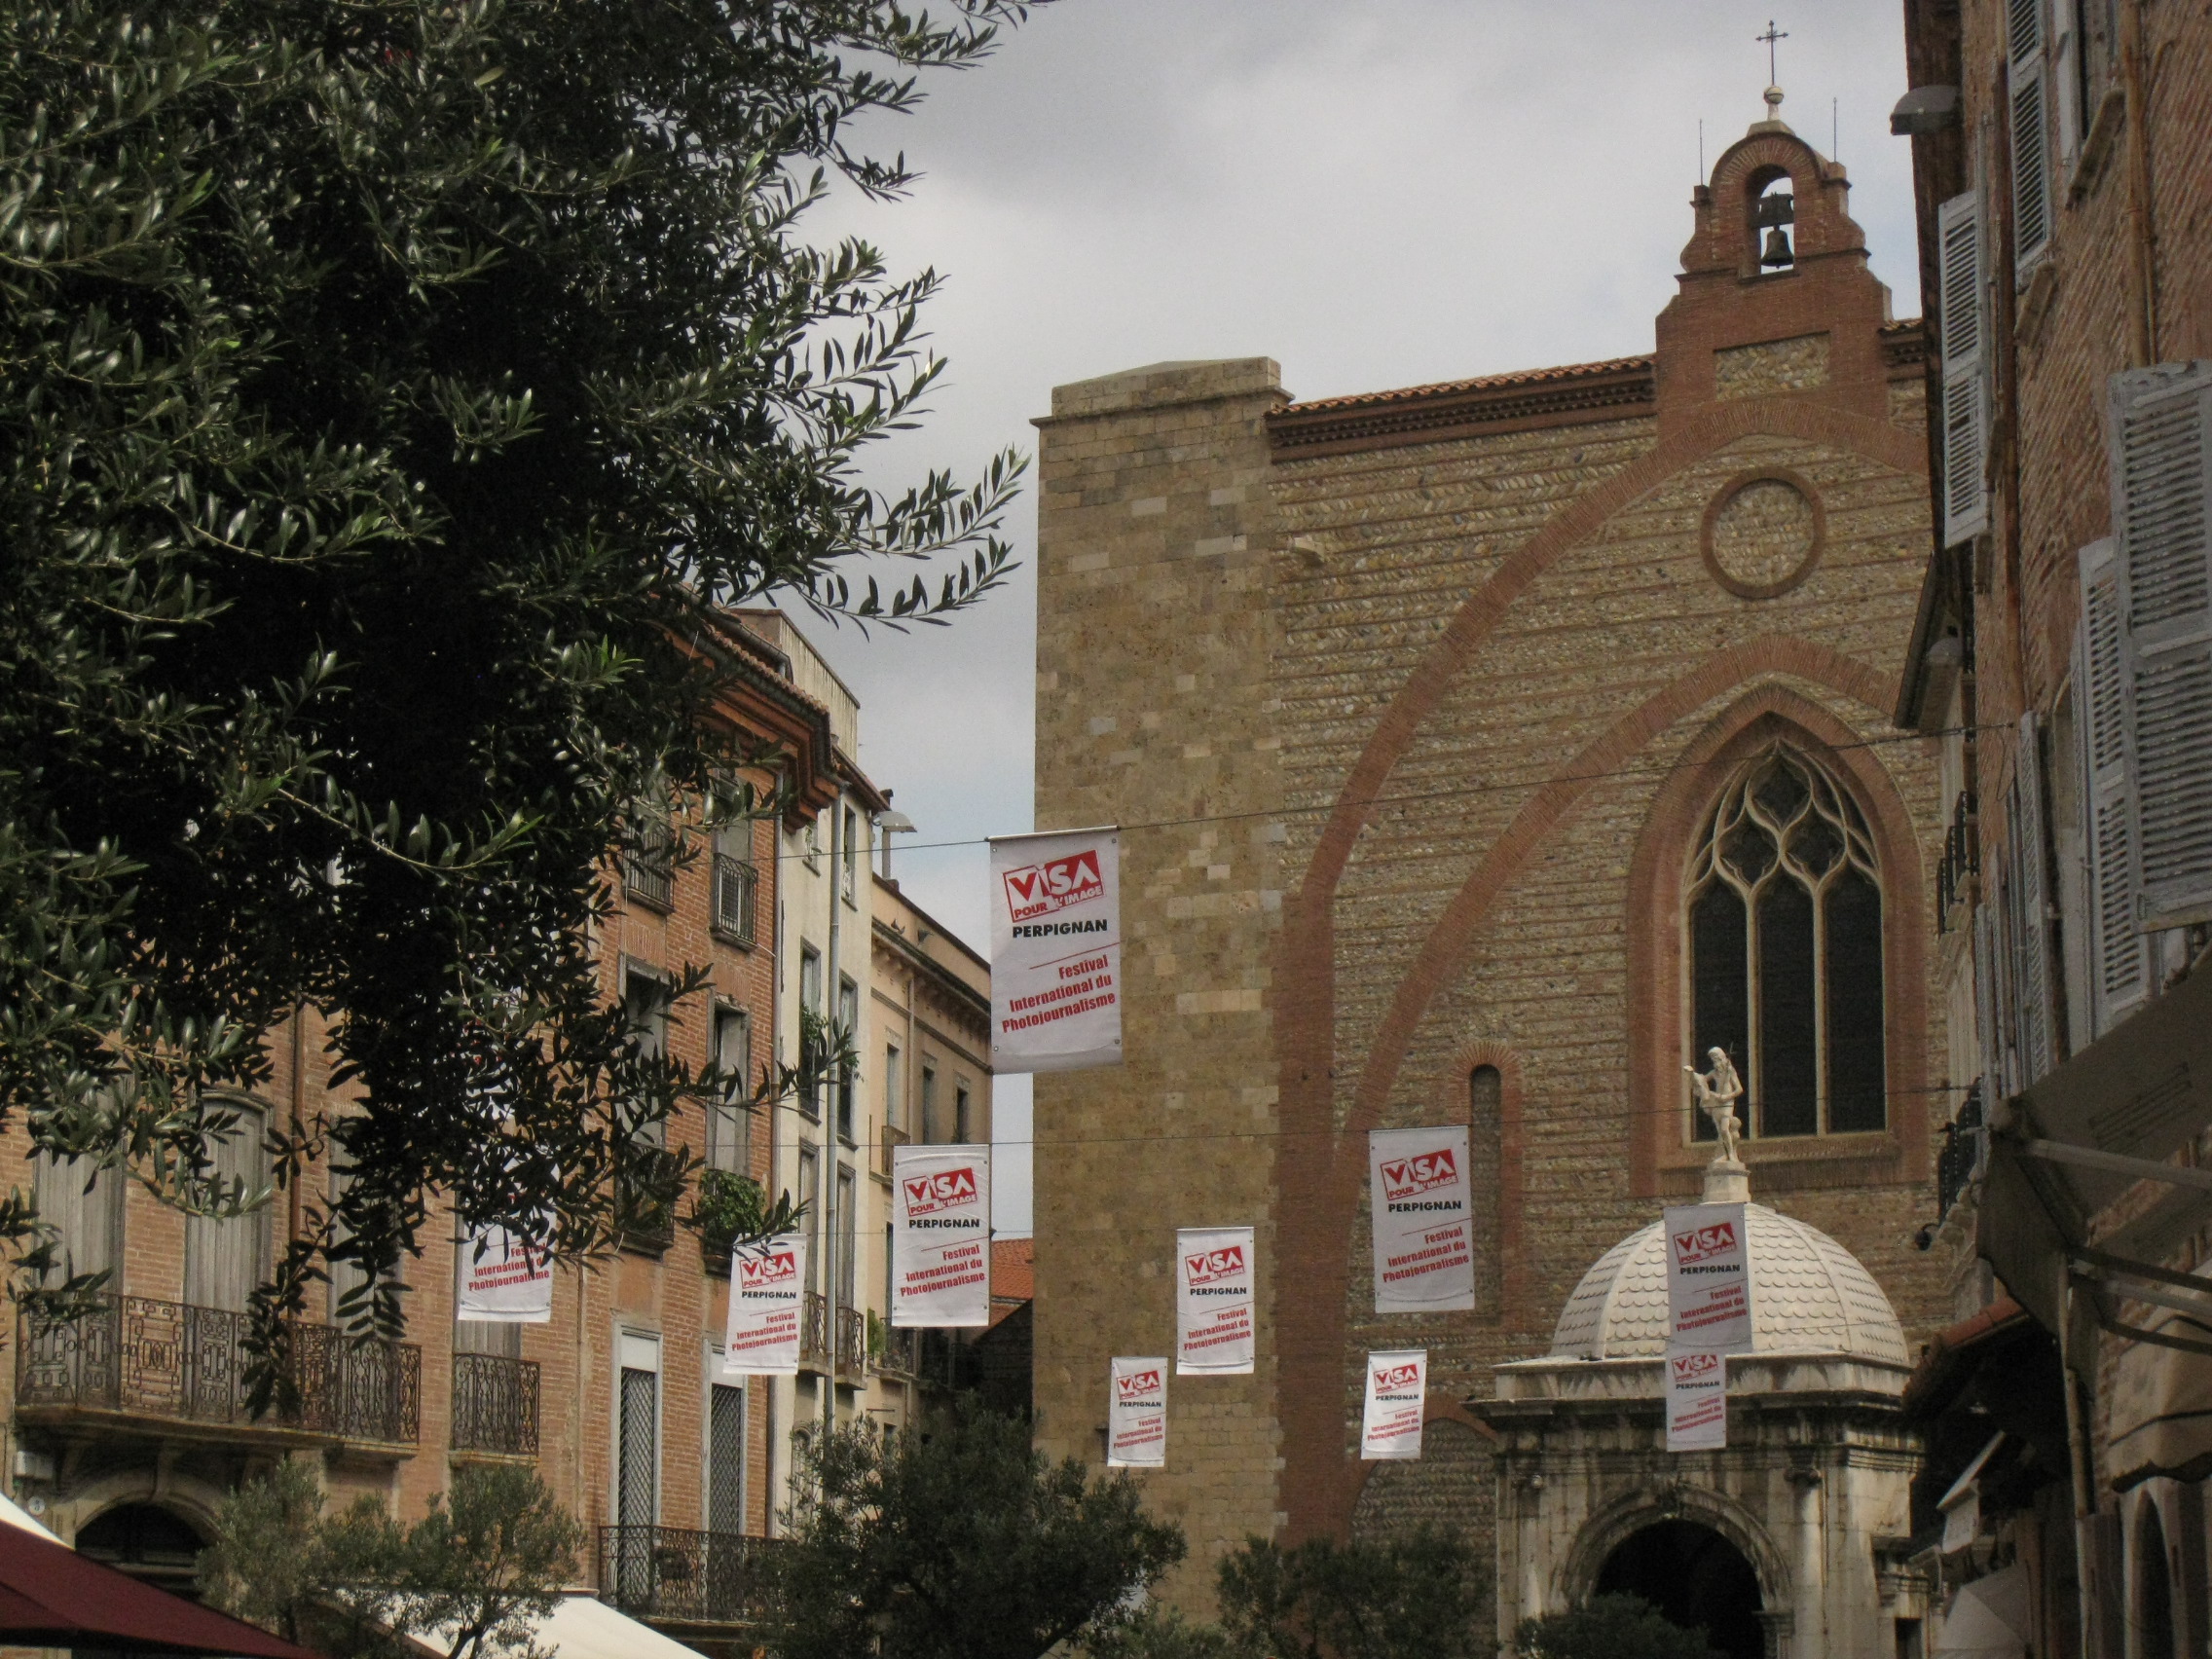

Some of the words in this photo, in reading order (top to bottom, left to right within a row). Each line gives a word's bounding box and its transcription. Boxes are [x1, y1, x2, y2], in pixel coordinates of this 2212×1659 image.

[1009, 859, 1100, 903] VISA
[1014, 901, 1048, 919] POUR
[1053, 884, 1103, 907] L'IMAGE
[1013, 919, 1108, 939] PERPIGNAN
[1058, 954, 1109, 979] Festival
[1010, 977, 1093, 1013] International
[1095, 974, 1112, 989] du
[1002, 992, 1116, 1033] Photojournalisme
[1384, 1156, 1456, 1185] VISA
[906, 1173, 975, 1201] VISA
[1389, 1186, 1414, 1198] POUR
[910, 1202, 935, 1214] POUR
[940, 1194, 977, 1209] L'IMAGE
[1388, 1200, 1461, 1212] PERPIGNAN
[908, 1219, 979, 1229] PERPIGNAN
[1424, 1226, 1462, 1244] Festival
[1677, 1228, 1732, 1253] VISA
[942, 1244, 979, 1261] Festival
[1188, 1251, 1242, 1273] VISA
[1387, 1242, 1452, 1268] International
[1453, 1240, 1466, 1251] du
[742, 1257, 793, 1277] VISA
[906, 1261, 969, 1282] International
[970, 1259, 982, 1269] du
[1382, 1254, 1469, 1282] Photojournalisme
[1680, 1265, 1740, 1274] PERPIGNAN
[468, 1270, 549, 1291] Photojournalime
[901, 1272, 985, 1297] Photojournalisme
[1191, 1274, 1210, 1284] POUR
[1190, 1287, 1247, 1296] PERPIGNAN
[766, 1312, 794, 1323] Festival
[1217, 1308, 1247, 1321] Festival
[737, 1323, 785, 1340] International
[1189, 1321, 1237, 1339] International
[1239, 1319, 1249, 1328] du
[732, 1333, 797, 1351] Photojournalisme
[1184, 1330, 1251, 1350] Photojournalisme
[1675, 1355, 1717, 1371] VISA
[1119, 1375, 1159, 1390] VISA
[1377, 1368, 1417, 1384] VISA
[1676, 1381, 1719, 1389] PERPIGNAN
